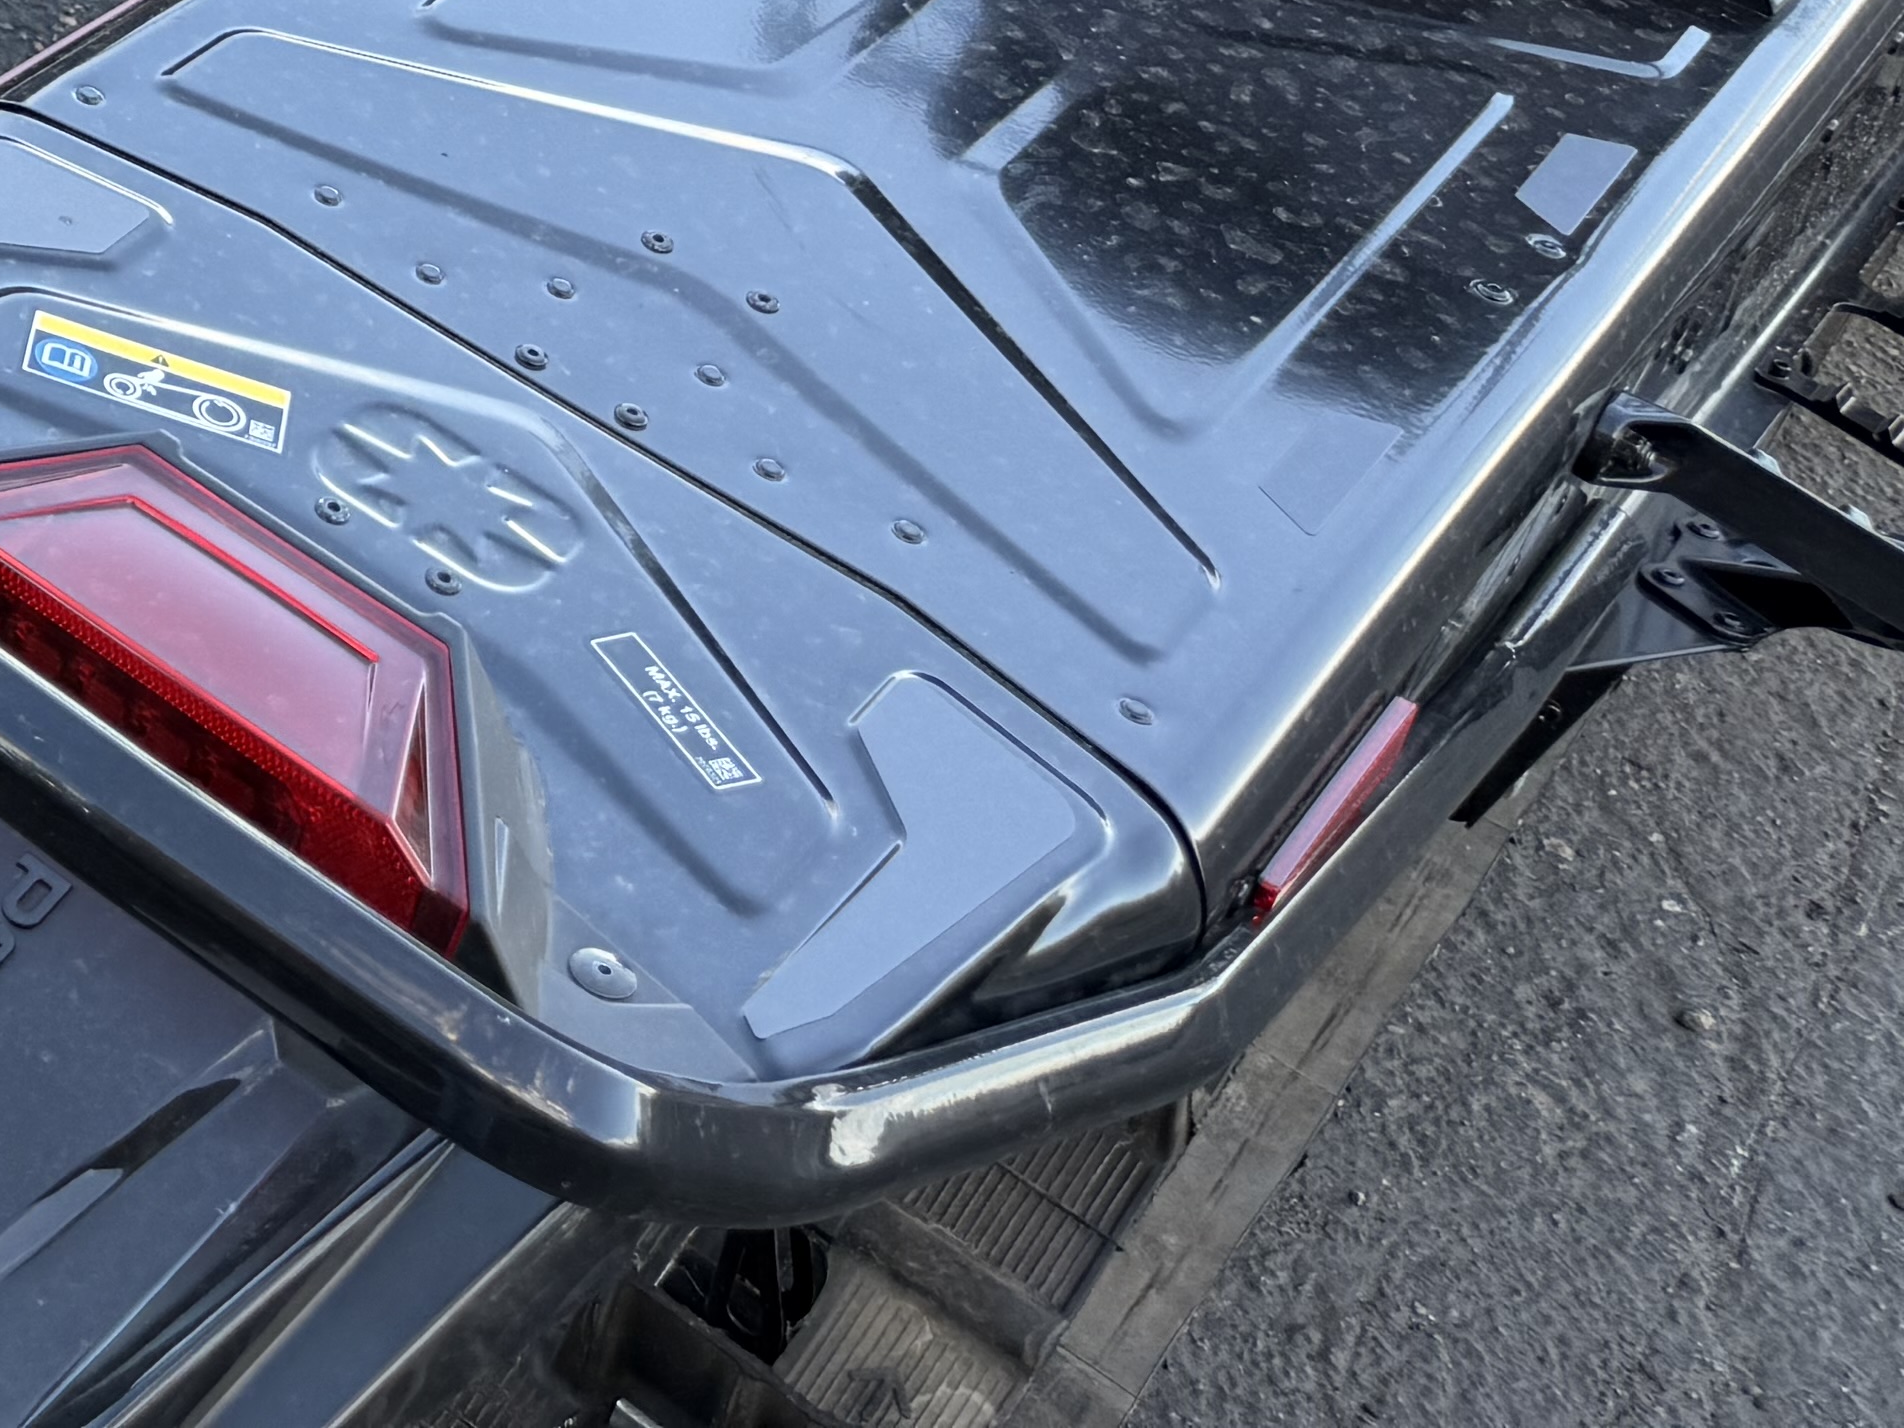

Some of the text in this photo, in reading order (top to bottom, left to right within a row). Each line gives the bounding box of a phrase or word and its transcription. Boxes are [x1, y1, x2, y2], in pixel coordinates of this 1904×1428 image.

[644, 665, 681, 703] MAX.
[680, 705, 701, 723] 15
[694, 724, 719, 751] lbs.
